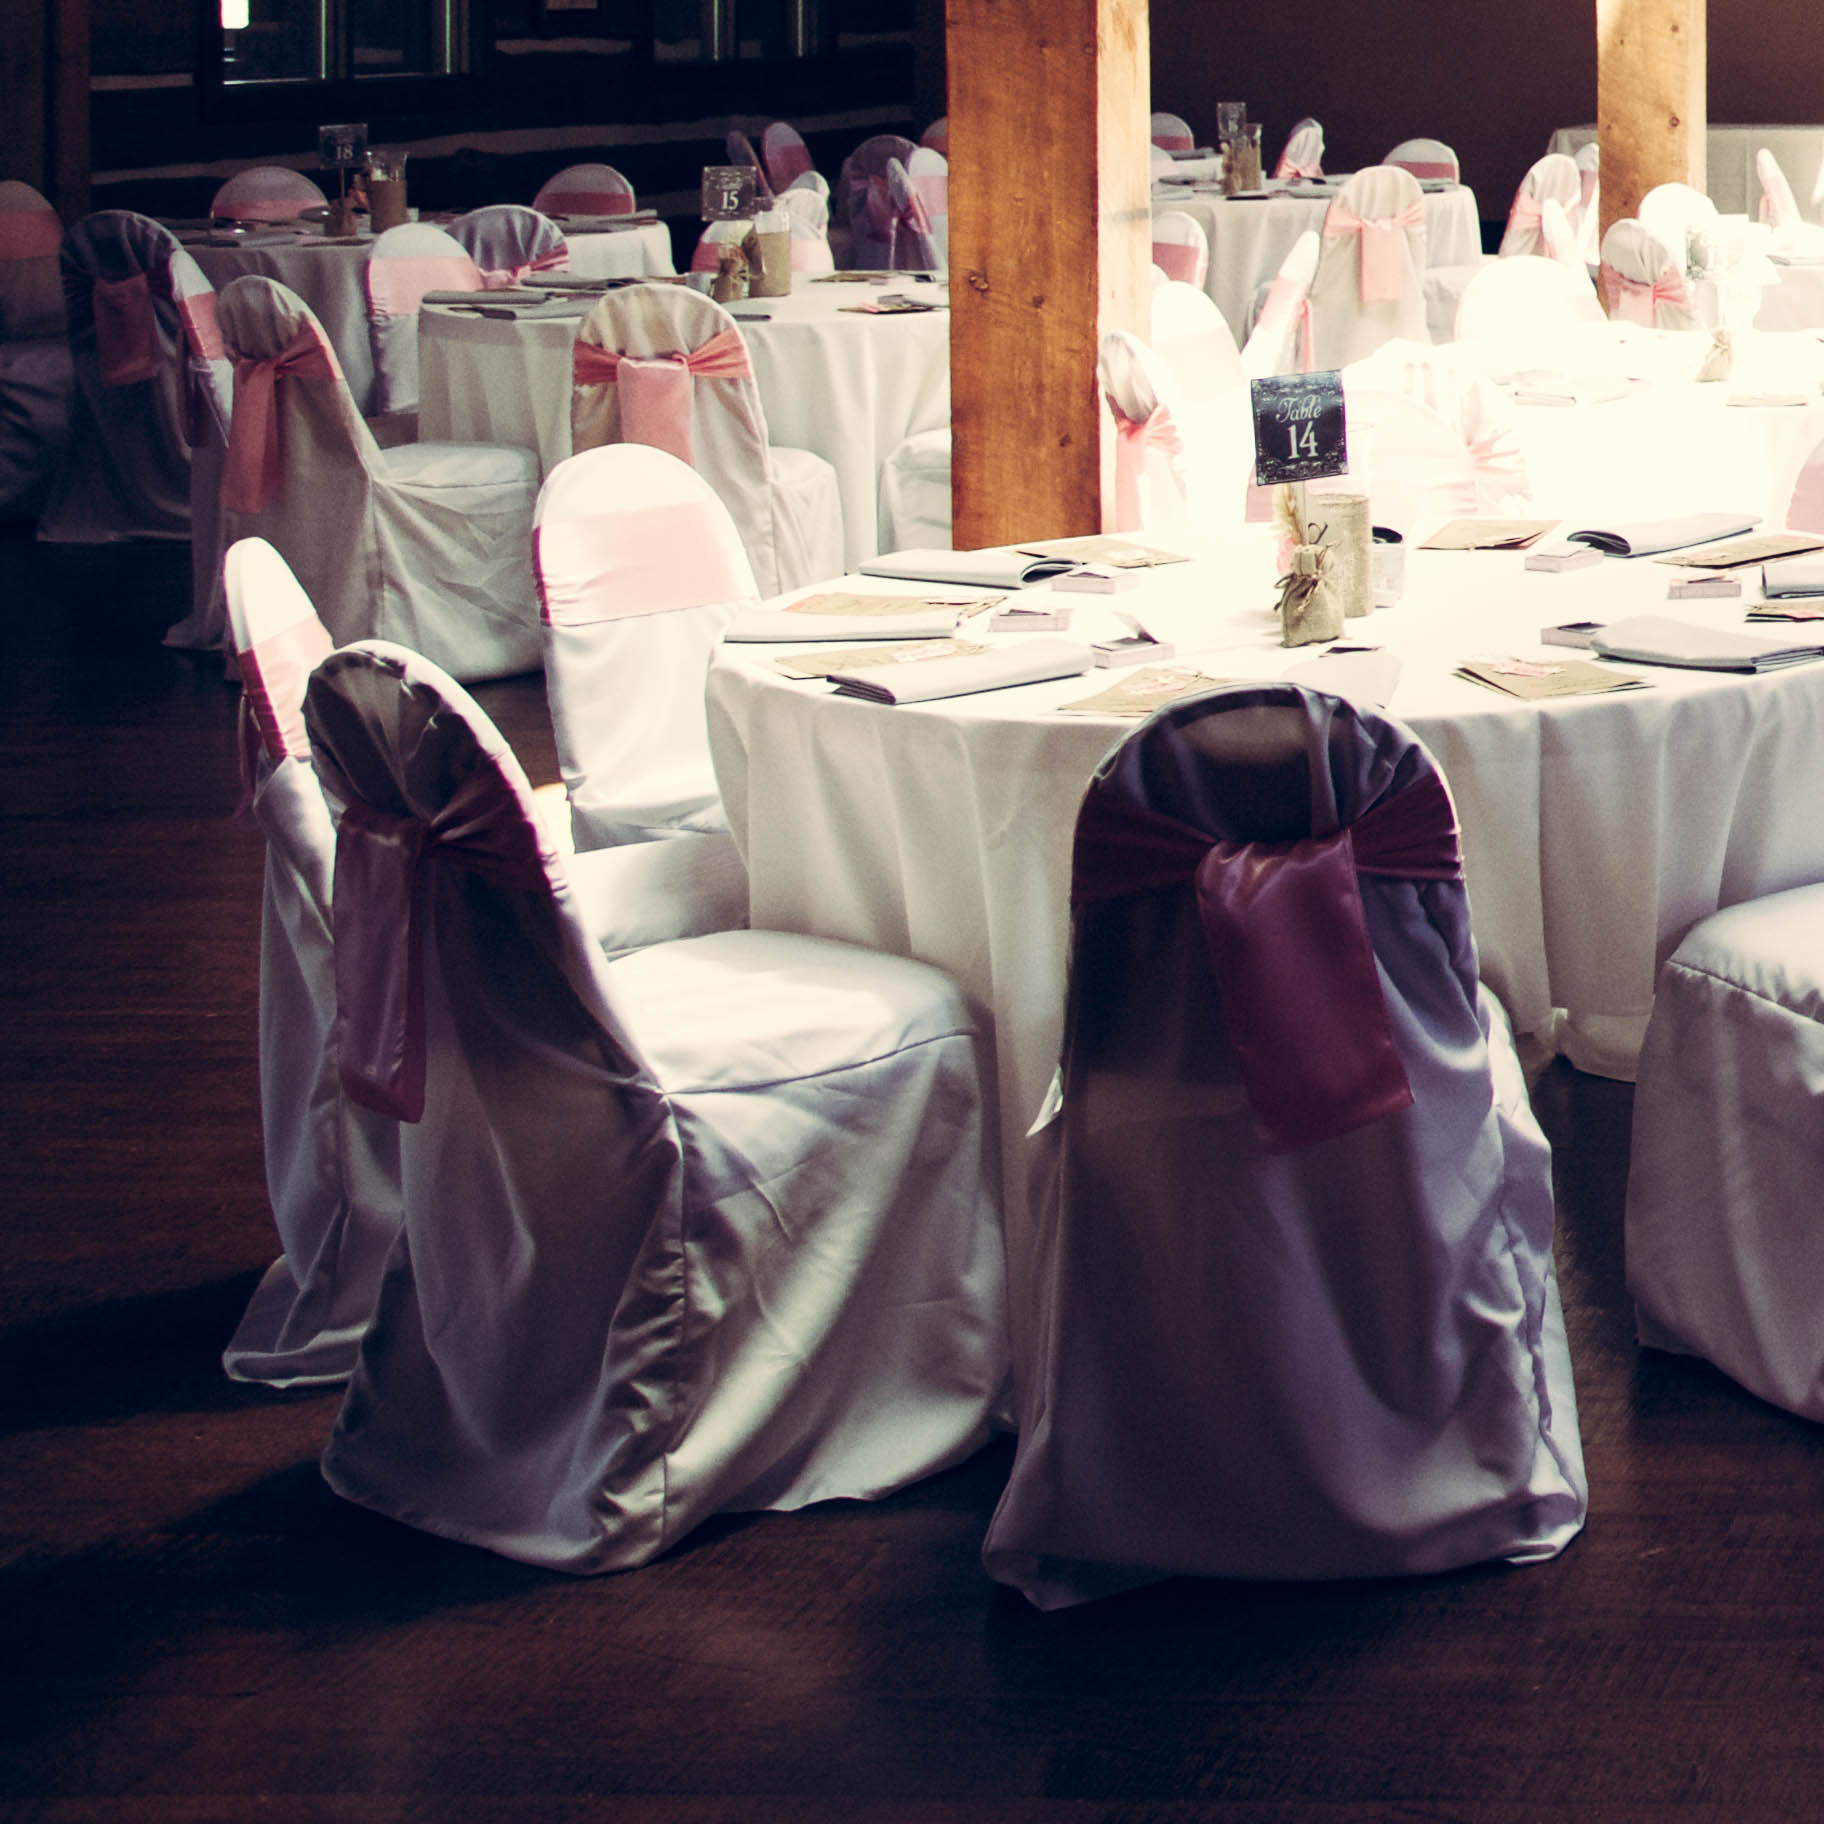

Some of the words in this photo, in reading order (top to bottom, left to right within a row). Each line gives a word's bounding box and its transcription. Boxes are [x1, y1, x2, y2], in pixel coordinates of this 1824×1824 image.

[721, 190, 739, 210] 15
[1275, 394, 1322, 423] Table
[1287, 421, 1319, 460] 14
